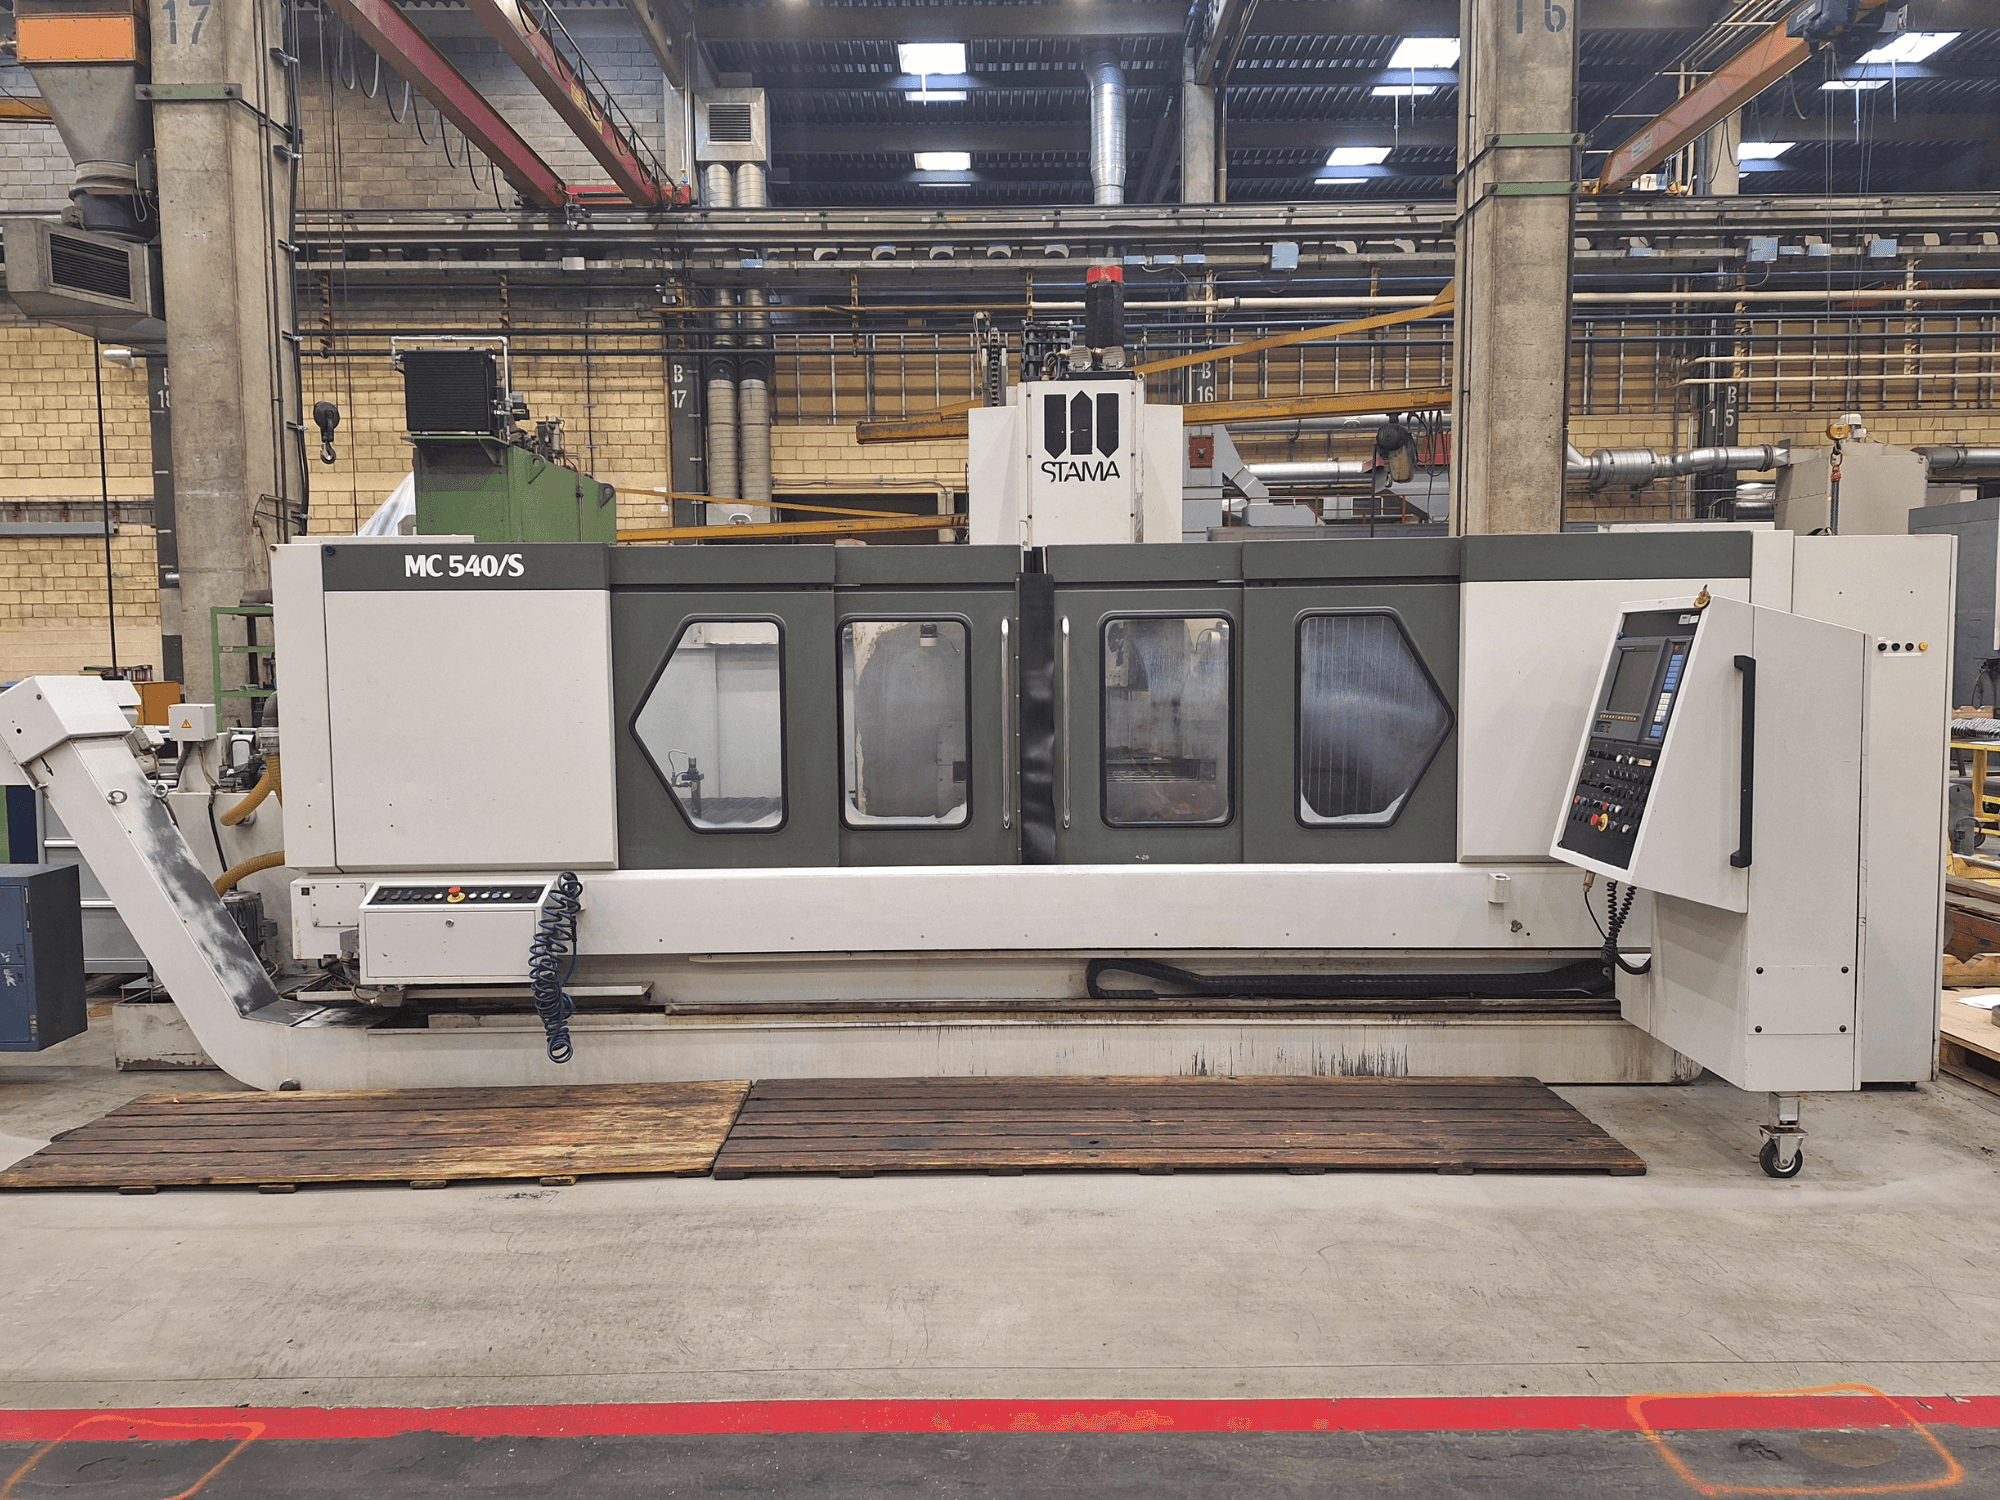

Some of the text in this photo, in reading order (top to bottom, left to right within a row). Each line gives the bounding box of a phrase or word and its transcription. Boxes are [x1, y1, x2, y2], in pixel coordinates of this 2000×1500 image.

[162, 0, 210, 45] 17
[1516, 0, 1567, 34] 16
[673, 364, 683, 383] B
[1202, 361, 1212, 380] B
[671, 389, 688, 409] 17
[1196, 385, 1214, 403] 16
[1727, 385, 1738, 405] B
[1041, 460, 1120, 483] STAMA
[404, 553, 525, 578] MC 540/S
